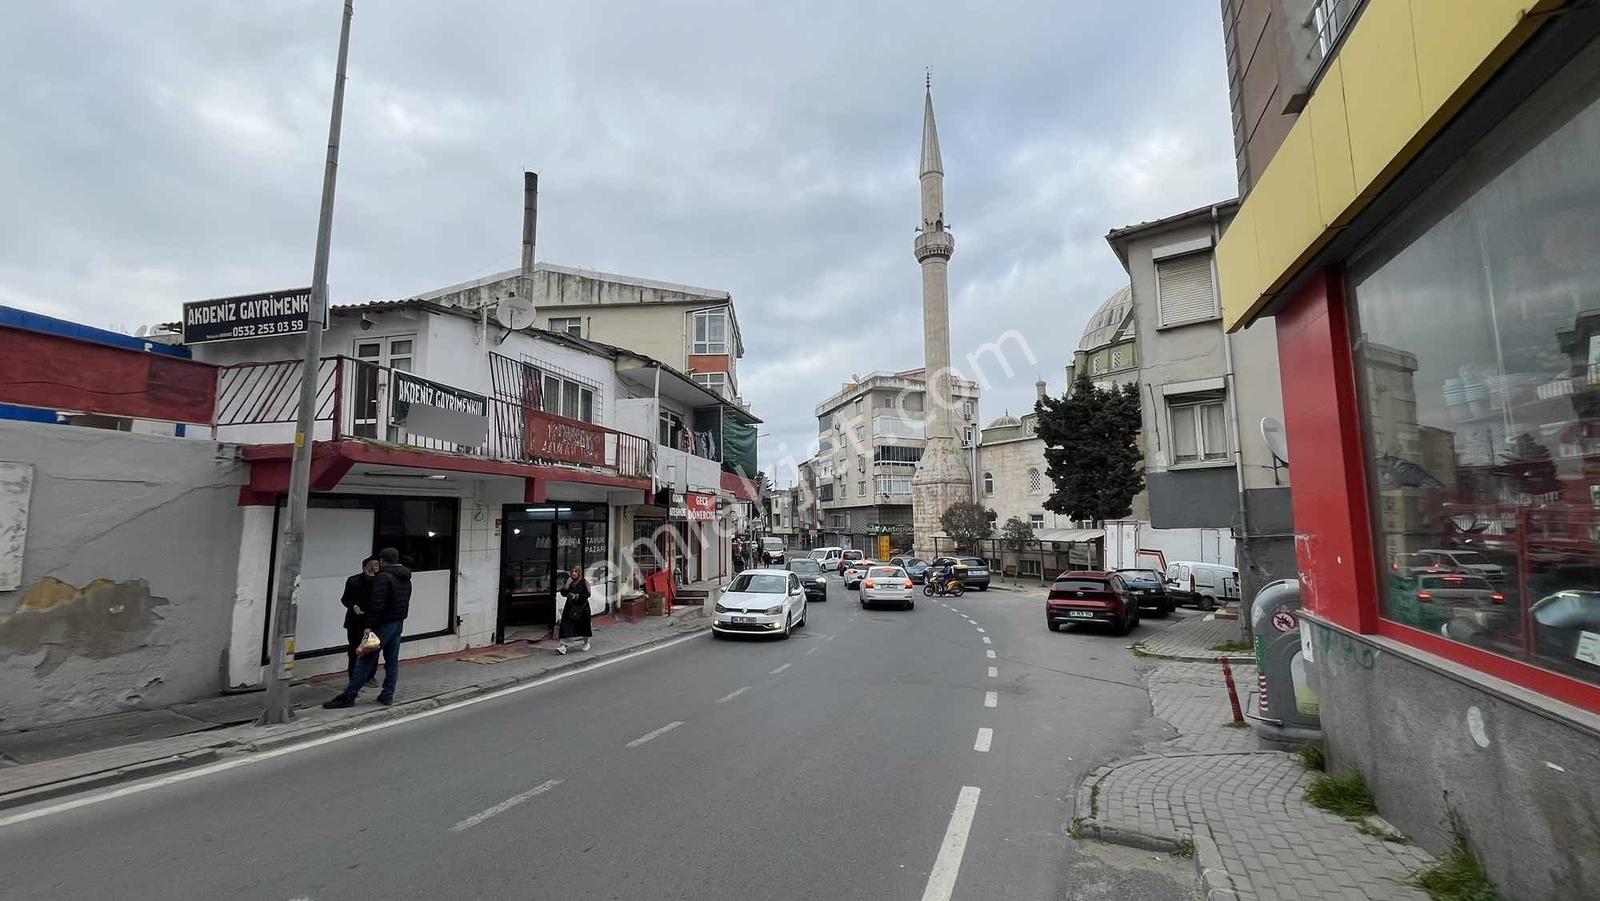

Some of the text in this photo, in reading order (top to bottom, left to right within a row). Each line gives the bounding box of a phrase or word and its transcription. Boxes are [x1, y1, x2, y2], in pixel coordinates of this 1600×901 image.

[188, 295, 310, 325] AKDENİZ GAYRİMENK
[232, 325, 256, 337] 0532
[257, 322, 275, 334] 253
[277, 320, 289, 333] 03
[291, 319, 304, 331] 59
[398, 380, 434, 406] AKDENİZ
